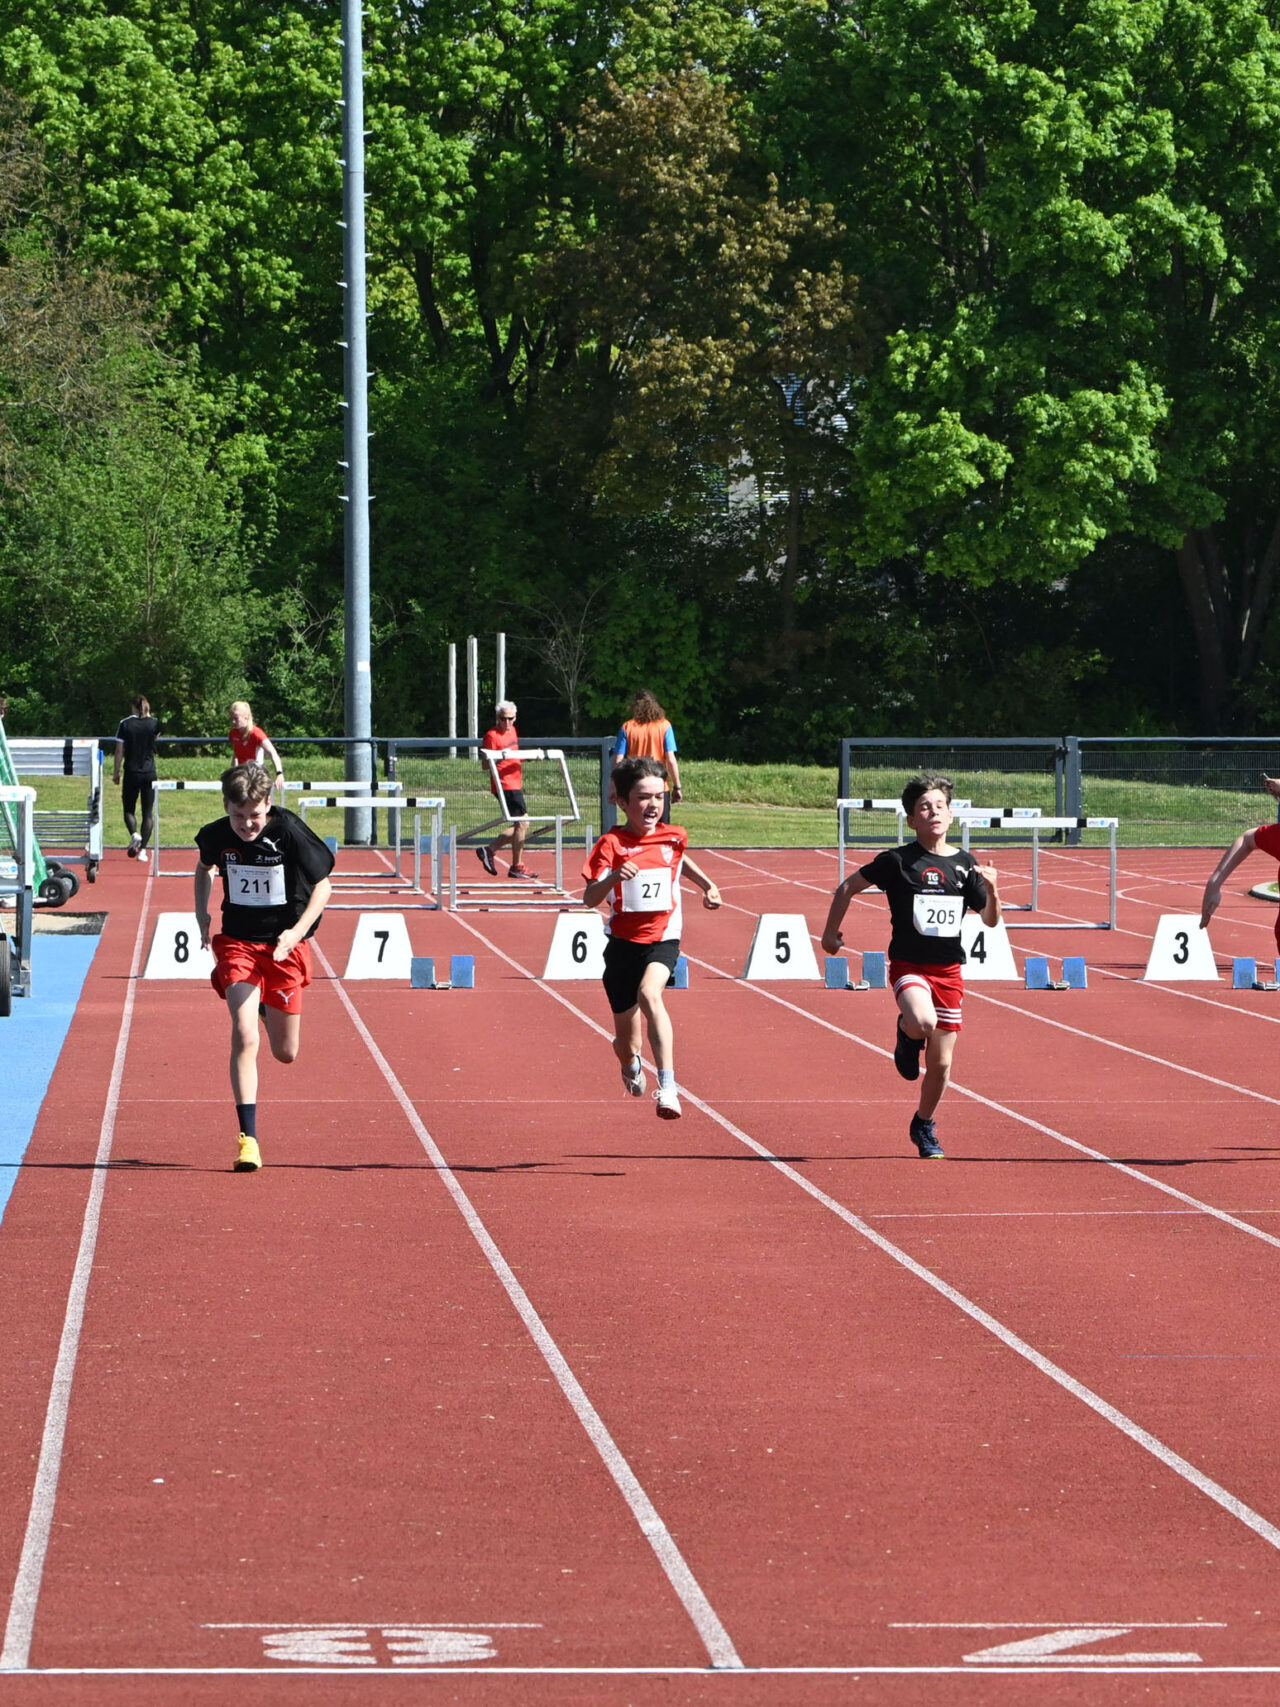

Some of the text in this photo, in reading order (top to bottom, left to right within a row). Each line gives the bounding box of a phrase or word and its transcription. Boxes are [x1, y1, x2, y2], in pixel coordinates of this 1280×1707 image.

[225, 852, 237, 861] TG
[240, 878, 271, 894] 211
[642, 882, 661, 899] 27
[926, 872, 939, 881] TG
[926, 908, 955, 925] 205
[174, 930, 189, 963] 8
[374, 930, 390, 963] 7
[571, 930, 588, 964] 6
[775, 931, 791, 964] 5
[970, 931, 987, 964] 4
[1173, 931, 1189, 964] 3
